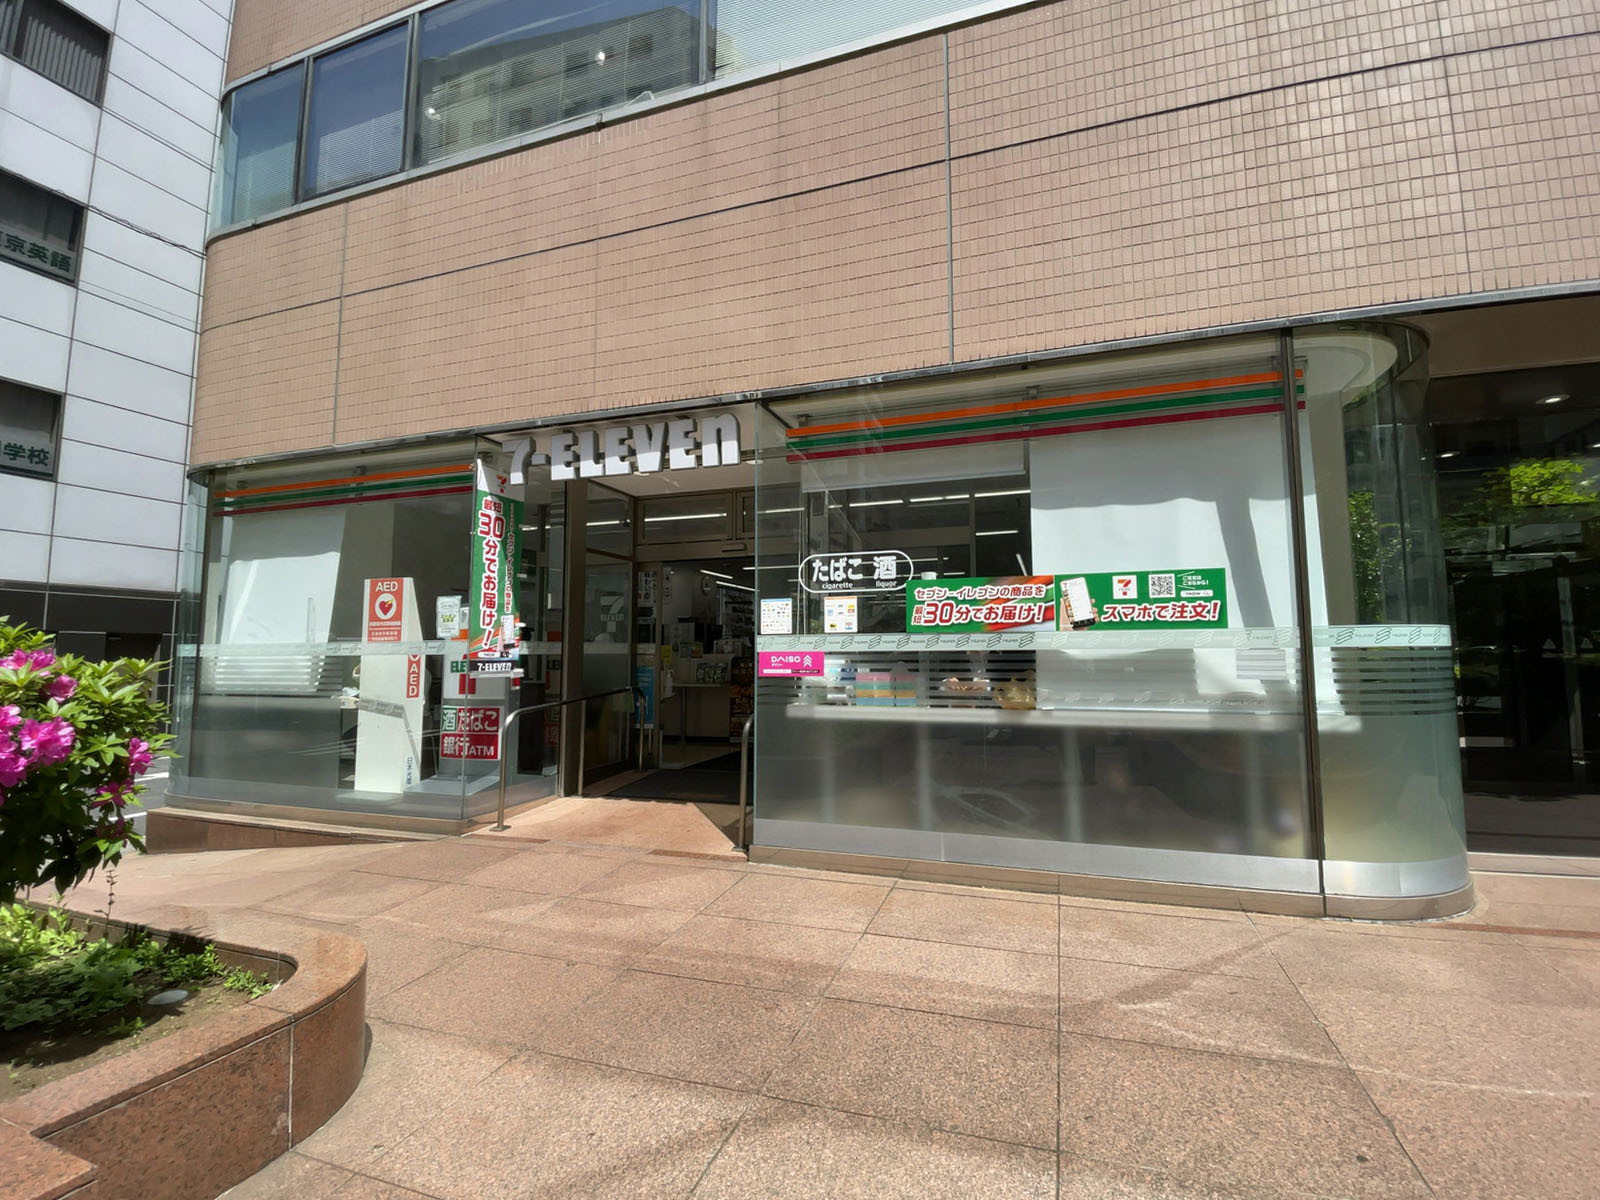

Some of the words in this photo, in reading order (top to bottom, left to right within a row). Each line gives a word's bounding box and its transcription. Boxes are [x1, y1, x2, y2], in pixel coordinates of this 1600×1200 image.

[0, 440, 49, 466] 学校
[812, 557, 863, 582] たばこ
[873, 555, 897, 579] 酒
[376, 581, 399, 593] AED
[822, 582, 854, 590] cigarette
[876, 580, 897, 588] liquor
[1101, 601, 1220, 621] スマホで注文!
[408, 660, 418, 697] AED
[442, 709, 456, 731] 酒
[458, 710, 498, 731] たばこ
